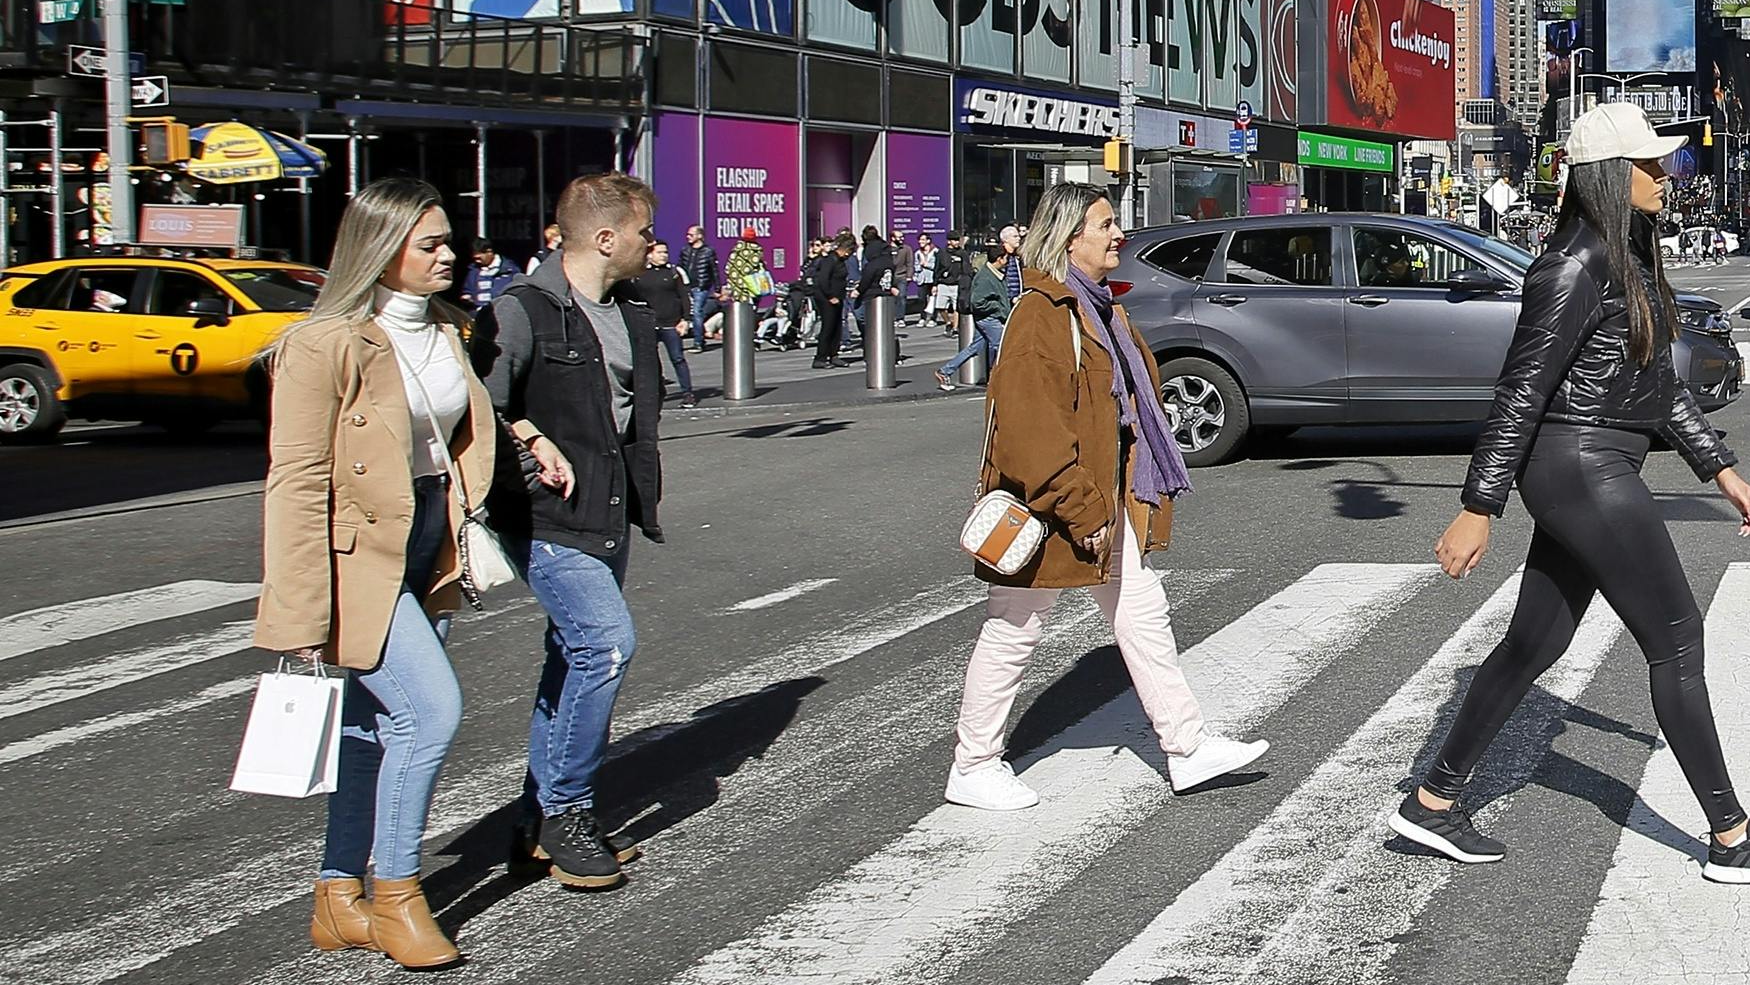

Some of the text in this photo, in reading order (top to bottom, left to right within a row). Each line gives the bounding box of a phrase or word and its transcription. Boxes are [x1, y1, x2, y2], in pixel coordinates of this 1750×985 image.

[969, 88, 1121, 137] SKECHERS
[1318, 142, 1333, 158] NEW
[1333, 144, 1348, 161] YORK
[1354, 147, 1367, 161] LINE
[1366, 148, 1385, 165] FRIENDS
[716, 166, 768, 189] FLAGSHIP
[716, 192, 785, 214] RETAIL SPACE
[716, 218, 738, 238] FOR
[176, 349, 195, 372] T
